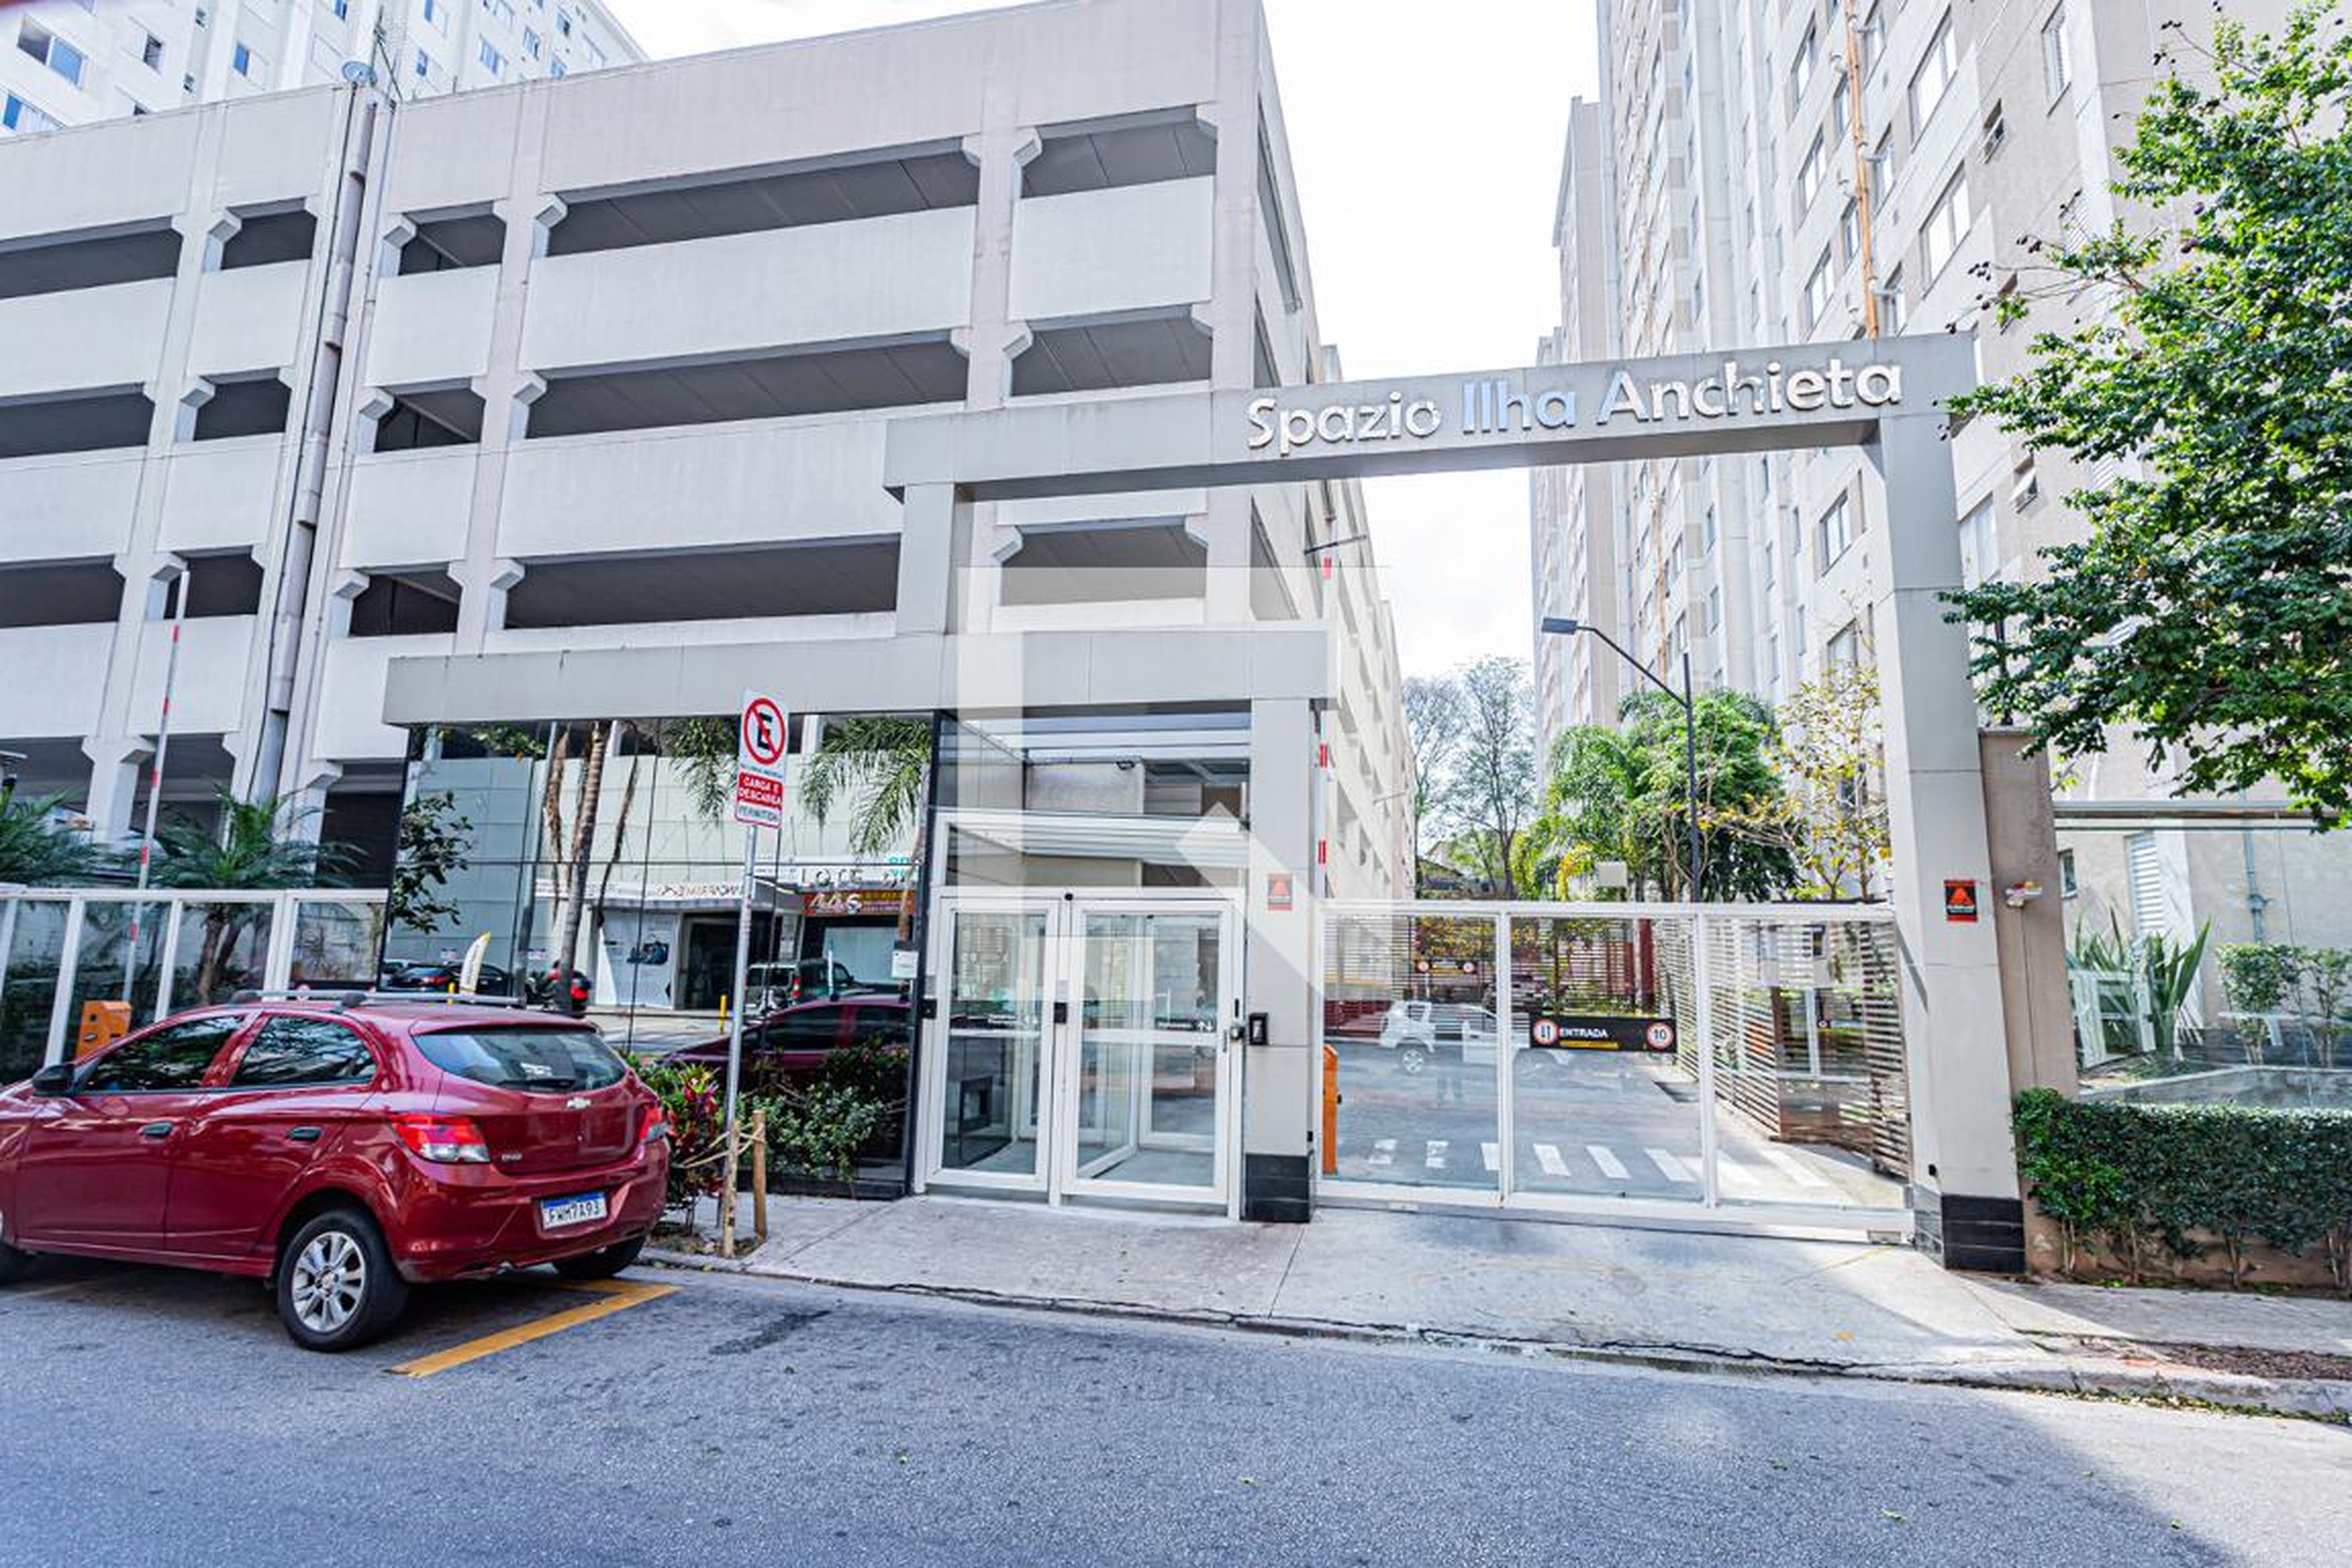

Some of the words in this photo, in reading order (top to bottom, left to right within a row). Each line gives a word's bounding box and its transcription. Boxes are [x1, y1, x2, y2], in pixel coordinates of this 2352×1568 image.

[1248, 391, 1440, 457] Spazio
[1463, 380, 1575, 434] Ilha
[1596, 359, 1902, 425] Anchieta
[1559, 1028, 1608, 1038] ENTRADA
[1653, 1028, 1667, 1040] 10
